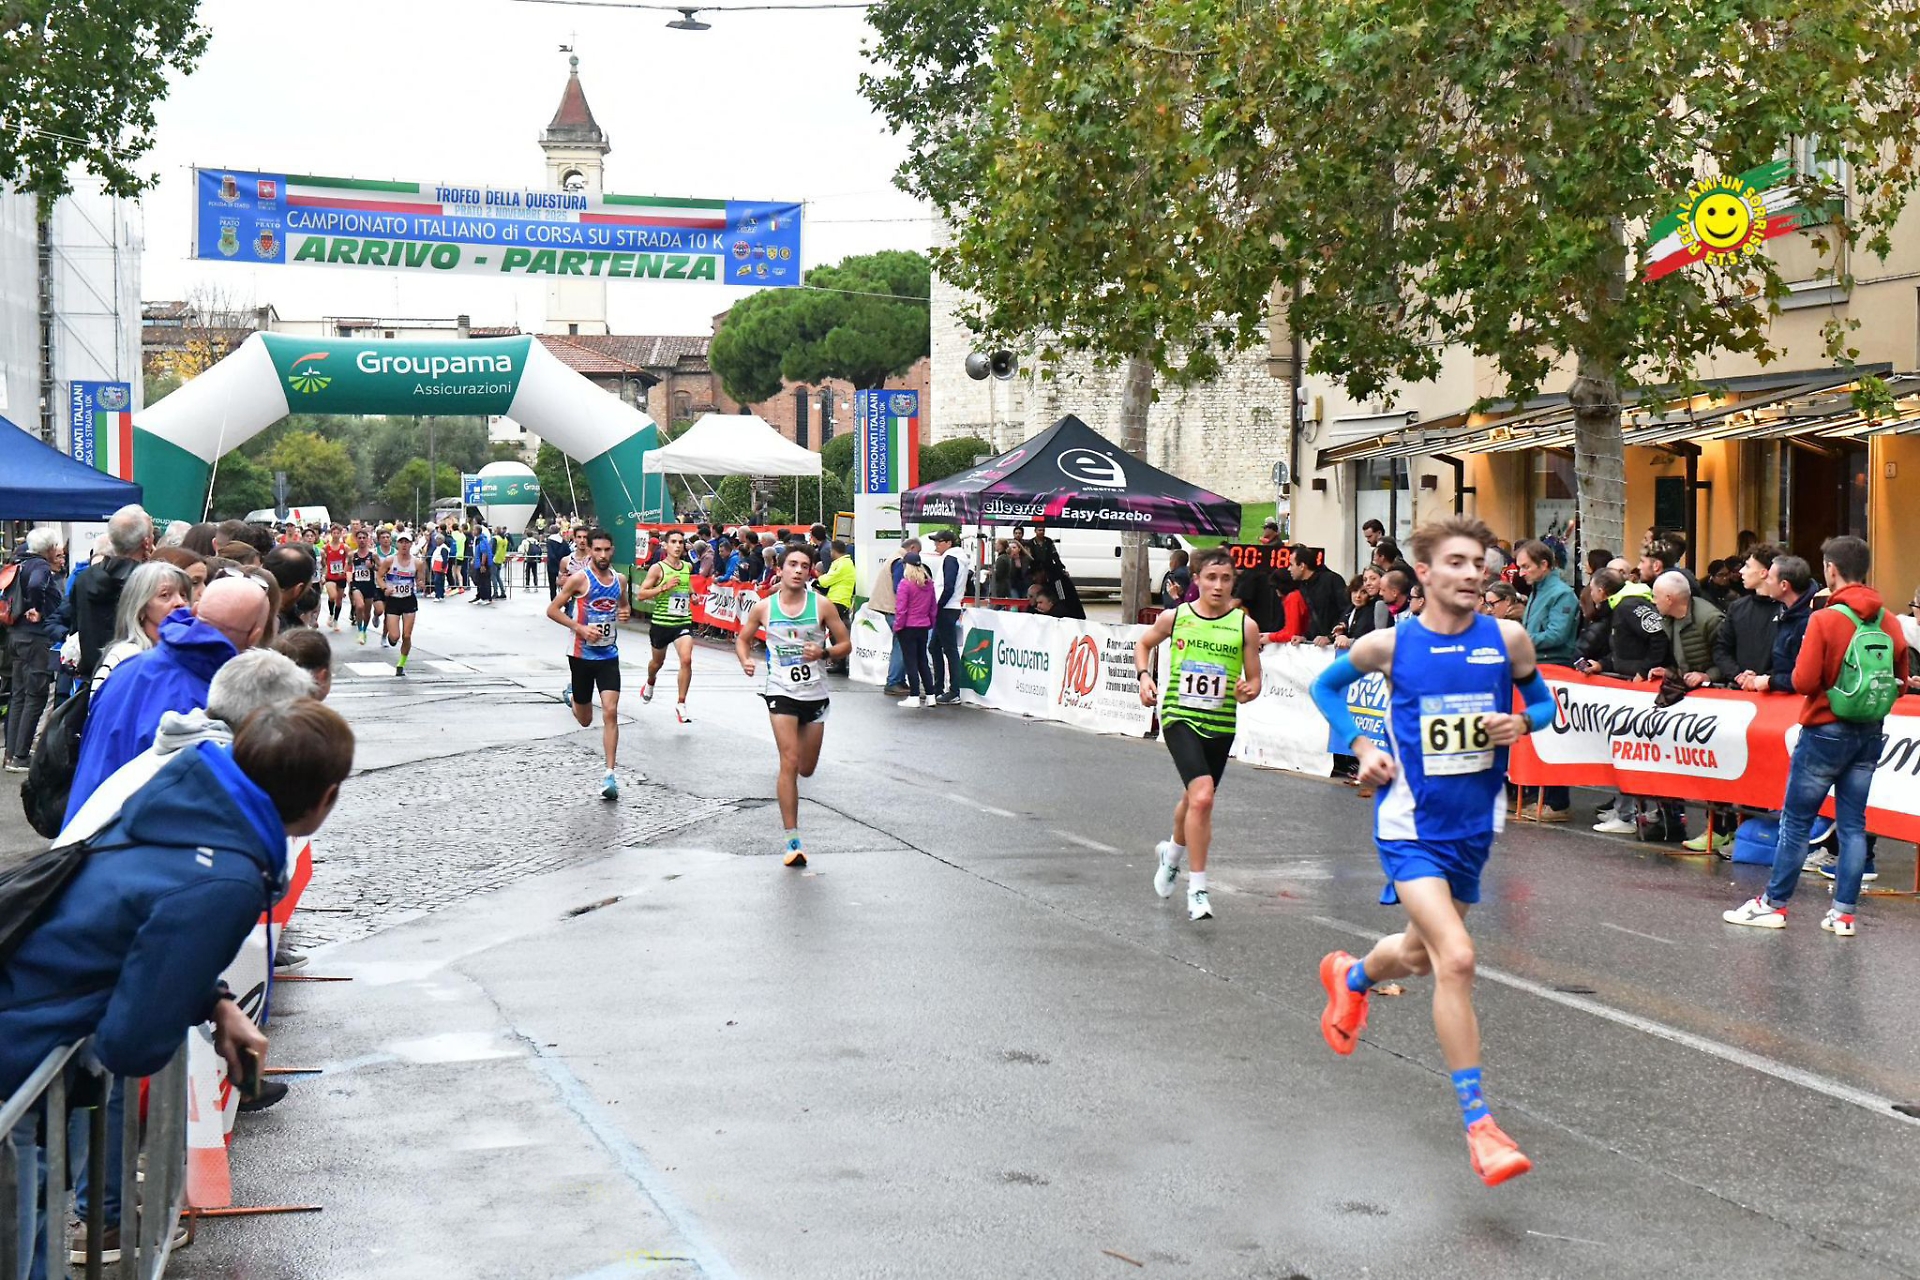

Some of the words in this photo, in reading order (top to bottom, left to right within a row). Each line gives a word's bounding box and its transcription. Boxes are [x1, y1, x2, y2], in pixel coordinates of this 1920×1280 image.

[435, 187, 480, 205] TROFEO
[486, 190, 520, 207] DELLA
[525, 193, 588, 211] QUESTURA
[454, 204, 483, 216] PRATO
[495, 207, 541, 219] NOVEMBRE
[544, 210, 568, 222] 2025
[286, 209, 408, 236] CAMPIONATO
[414, 218, 497, 240] ITALIANO
[502, 224, 519, 241] di
[525, 225, 584, 245] CORSA
[588, 227, 611, 246] SU
[616, 230, 683, 249] STRADA
[688, 233, 707, 250] 10
[713, 234, 724, 250] K
[293, 235, 461, 270] ARRIVO
[500, 247, 716, 281] PARTENZA
[356, 350, 512, 379] Groupama
[413, 381, 512, 396] Assicurazioni
[73, 385, 83, 426] ITALIANI
[869, 393, 878, 431] ITALIANI
[878, 402, 886, 414] 10K
[85, 409, 93, 438] STRADA
[74, 429, 84, 461] IONATI
[879, 442, 886, 452] SU
[870, 433, 879, 492] CAMPIONATI
[879, 453, 887, 475] CORSA
[922, 498, 956, 517] evodata.it
[984, 499, 1045, 516] elleerre
[1061, 507, 1153, 522] Easy-Gazebo
[356, 569, 370, 578] 163
[394, 585, 410, 593] 108
[674, 598, 686, 609] 73
[997, 638, 1049, 675] Groupama
[1187, 639, 1239, 655] MERCURIO
[790, 664, 811, 683] 69
[1185, 674, 1221, 697] 161
[1429, 715, 1490, 751] 618
[1611, 740, 1661, 763] PRATO
[1674, 746, 1719, 769] LUCCA
